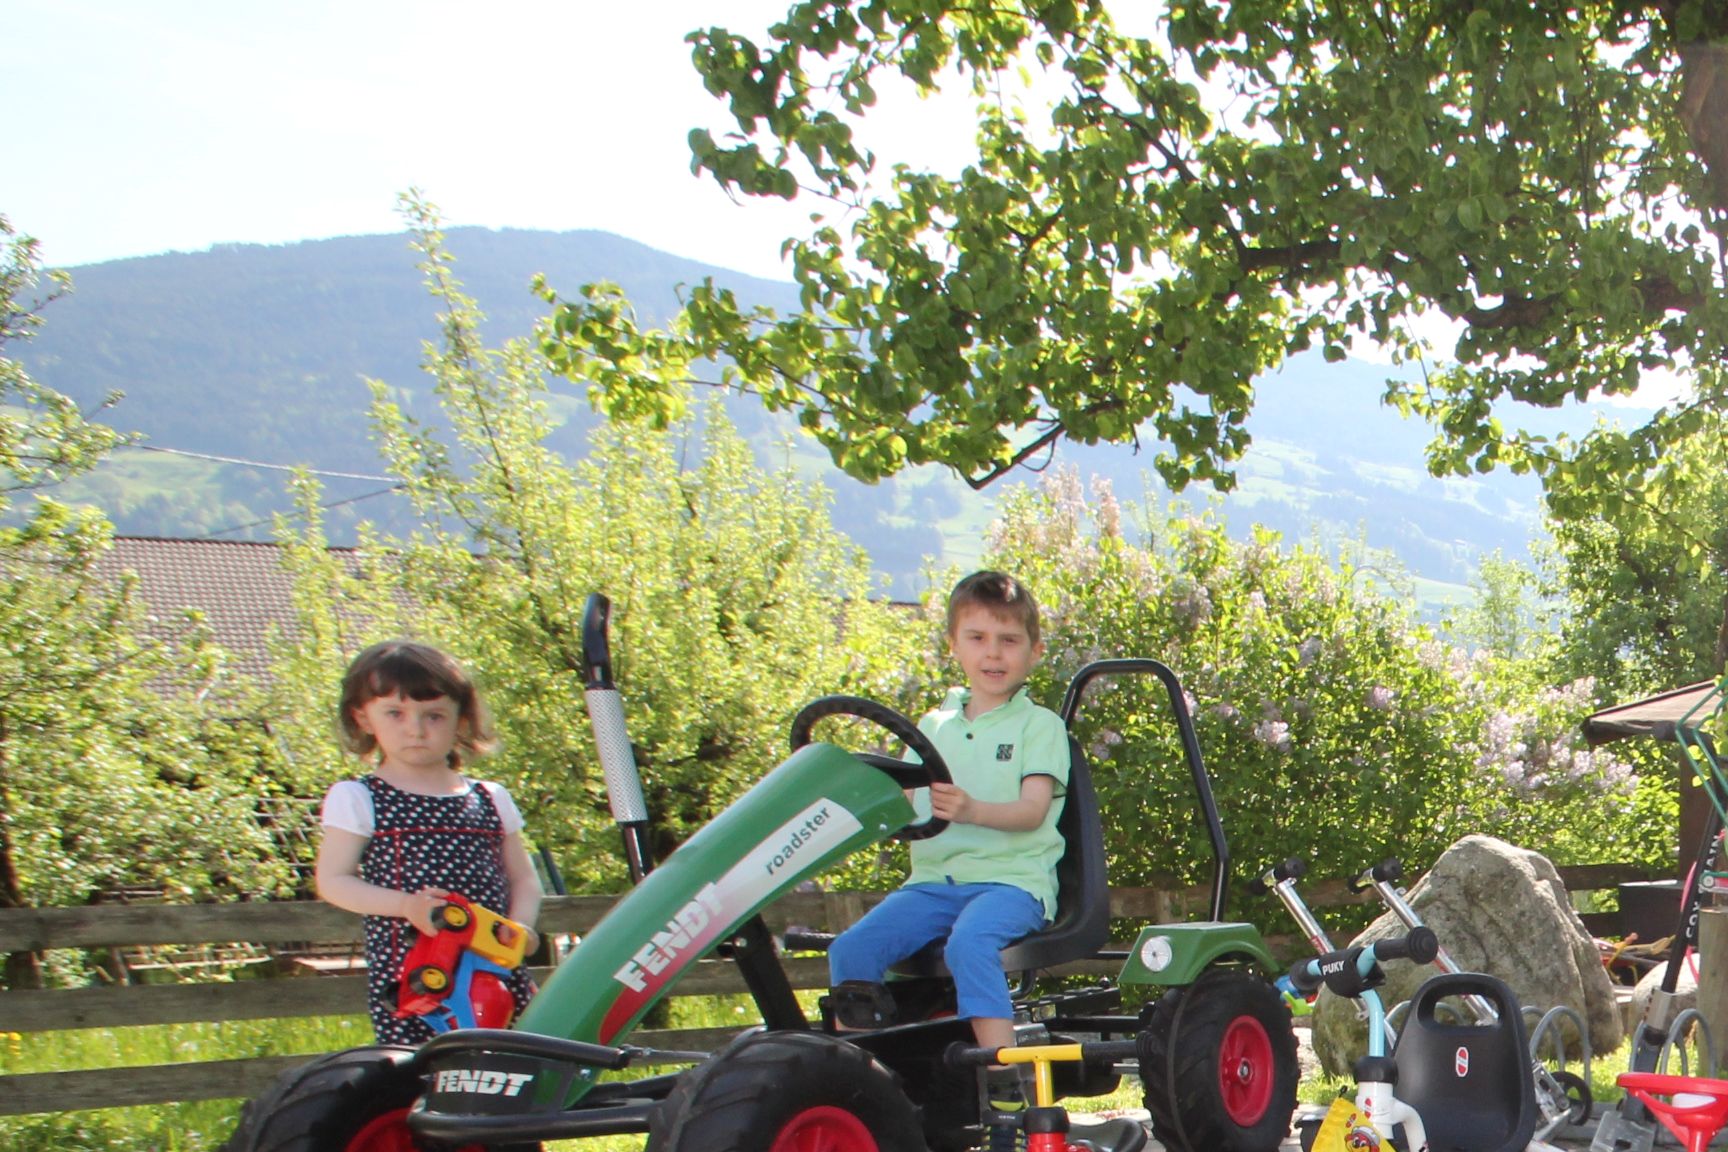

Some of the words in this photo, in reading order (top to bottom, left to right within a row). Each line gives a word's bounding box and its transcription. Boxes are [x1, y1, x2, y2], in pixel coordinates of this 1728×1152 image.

[766, 806, 831, 876] roadster
[613, 879, 724, 993] FENDT
[1322, 960, 1345, 976] PUKY
[437, 1069, 534, 1097] FENDT
